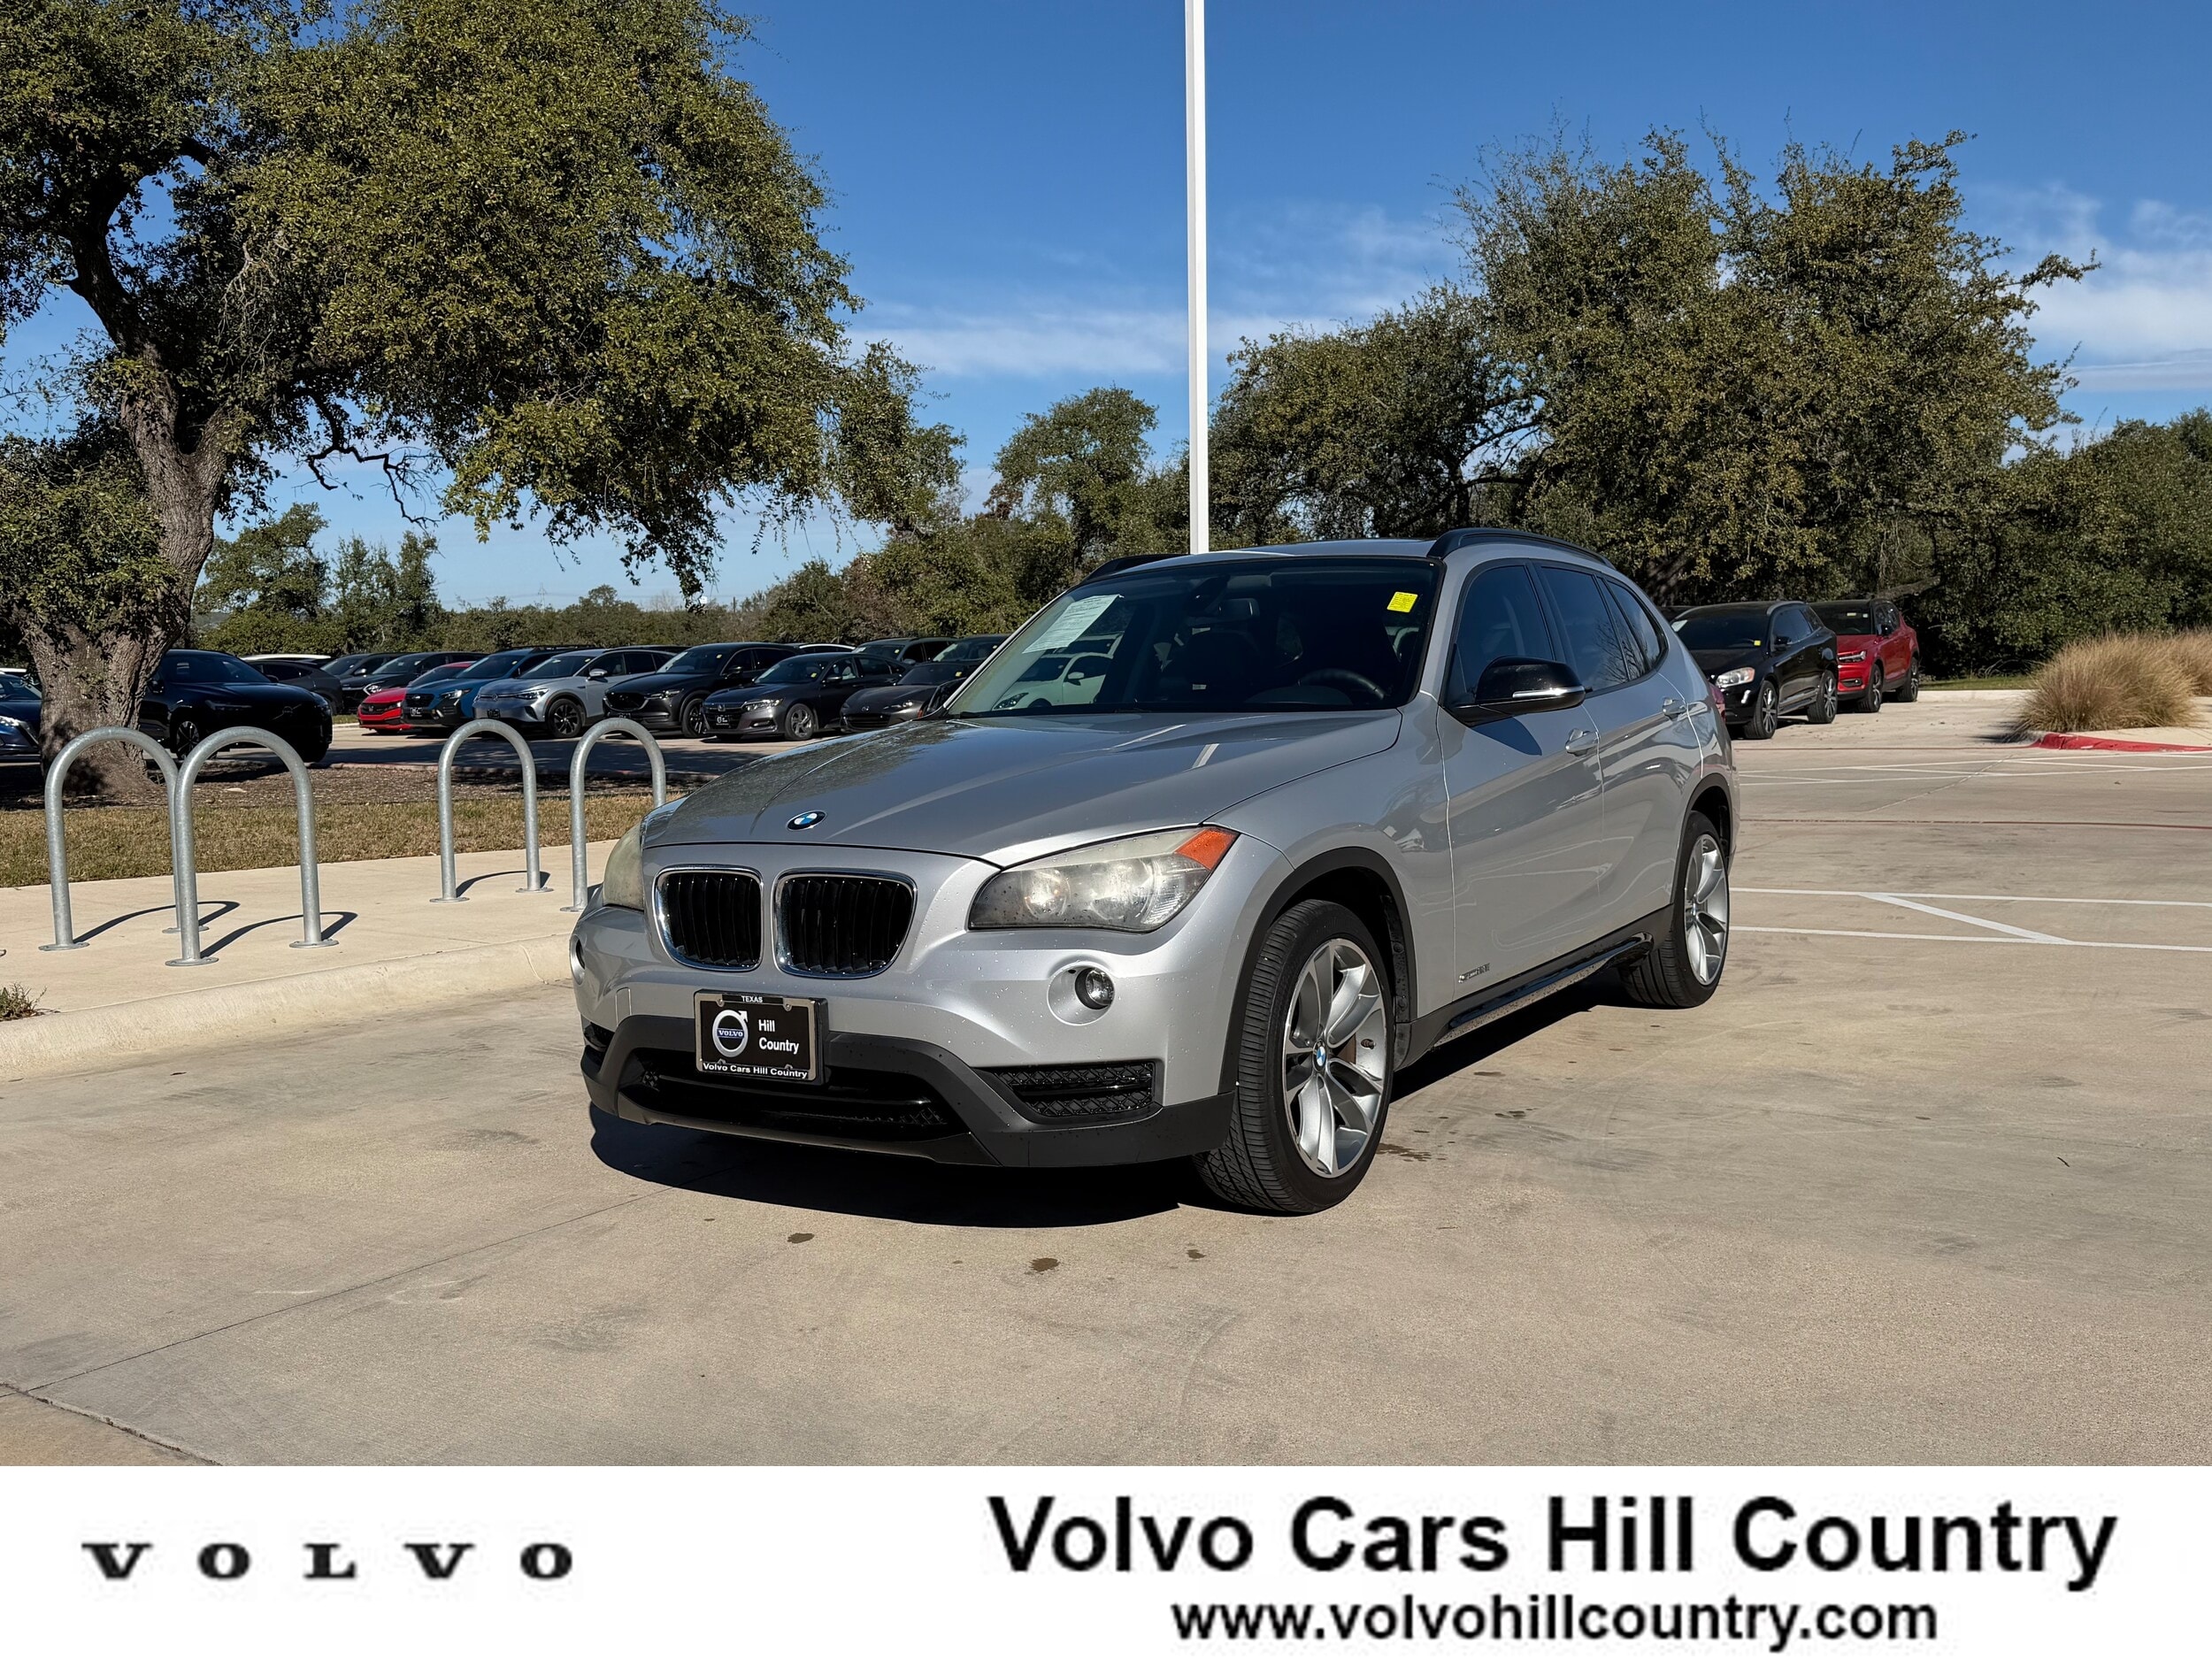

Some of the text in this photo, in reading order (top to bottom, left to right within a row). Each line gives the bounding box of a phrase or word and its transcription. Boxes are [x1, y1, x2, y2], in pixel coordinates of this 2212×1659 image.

[718, 1029, 744, 1038] VOLVO
[758, 1019, 776, 1033] Hill
[758, 1037, 800, 1055] Country
[703, 1063, 808, 1079] Volvo Cars Hill Country
